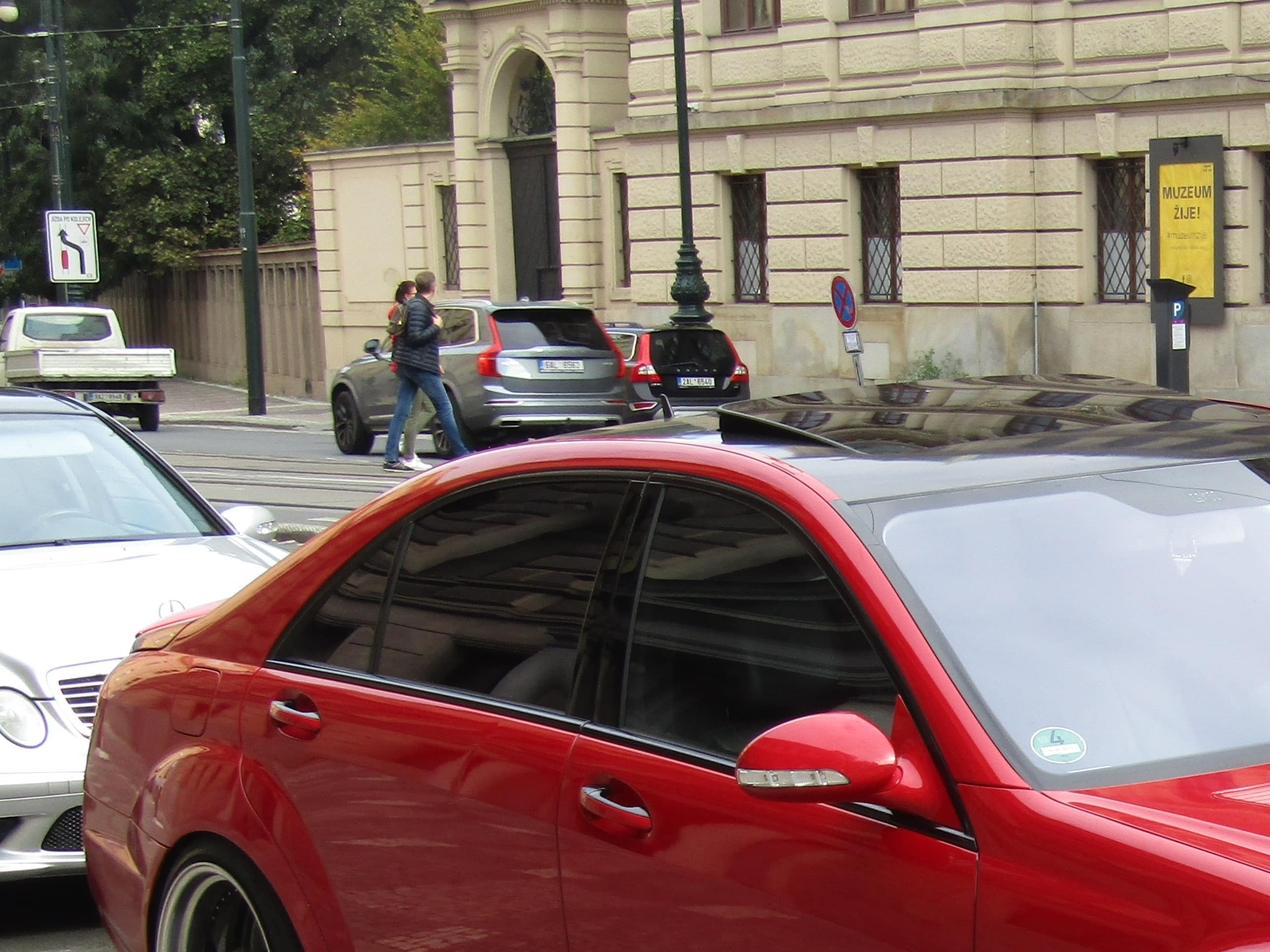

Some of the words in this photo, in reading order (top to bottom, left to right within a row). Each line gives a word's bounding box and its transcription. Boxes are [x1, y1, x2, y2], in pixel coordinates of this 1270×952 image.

[1162, 186, 1212, 199] MUZEUM
[1174, 205, 1200, 220] ŽIJE!
[1173, 303, 1181, 316] P
[1050, 730, 1064, 745] 4
